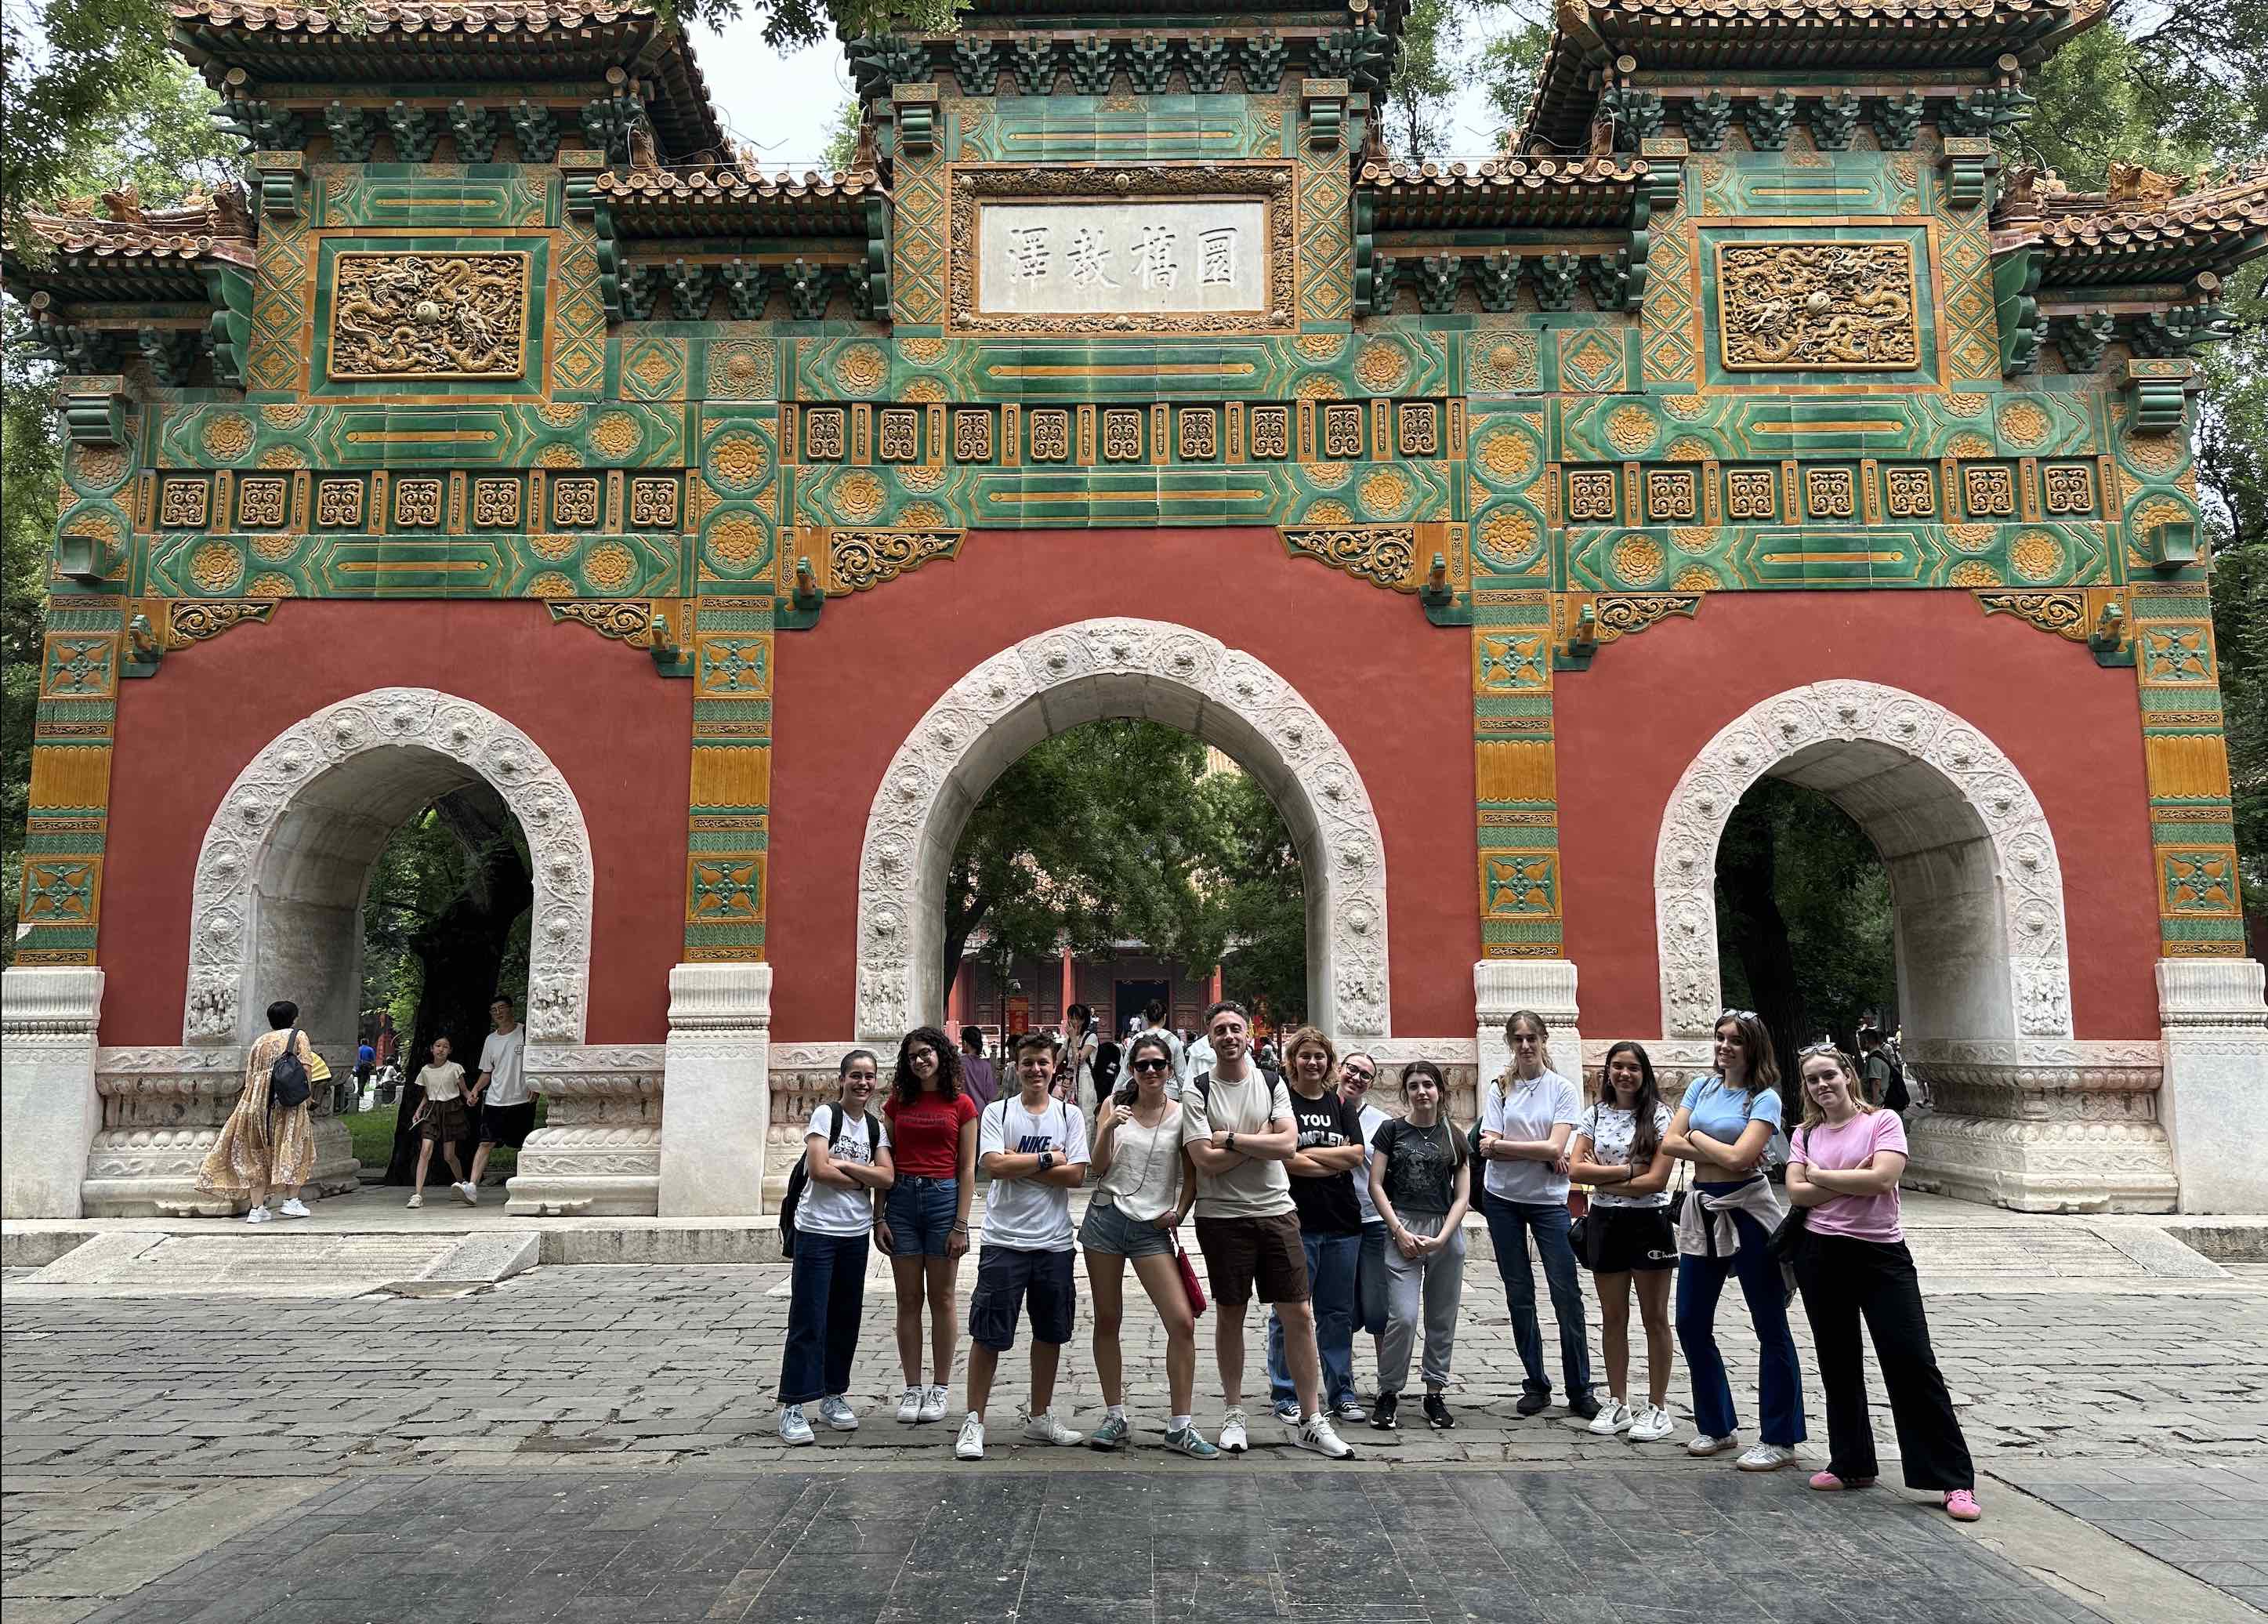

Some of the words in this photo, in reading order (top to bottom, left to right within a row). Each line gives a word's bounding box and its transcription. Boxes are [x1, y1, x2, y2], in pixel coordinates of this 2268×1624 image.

[1299, 1114, 1331, 1127] YOU
[1016, 1135, 1052, 1153] NIKE
[1297, 1129, 1344, 1147] OMPLET
